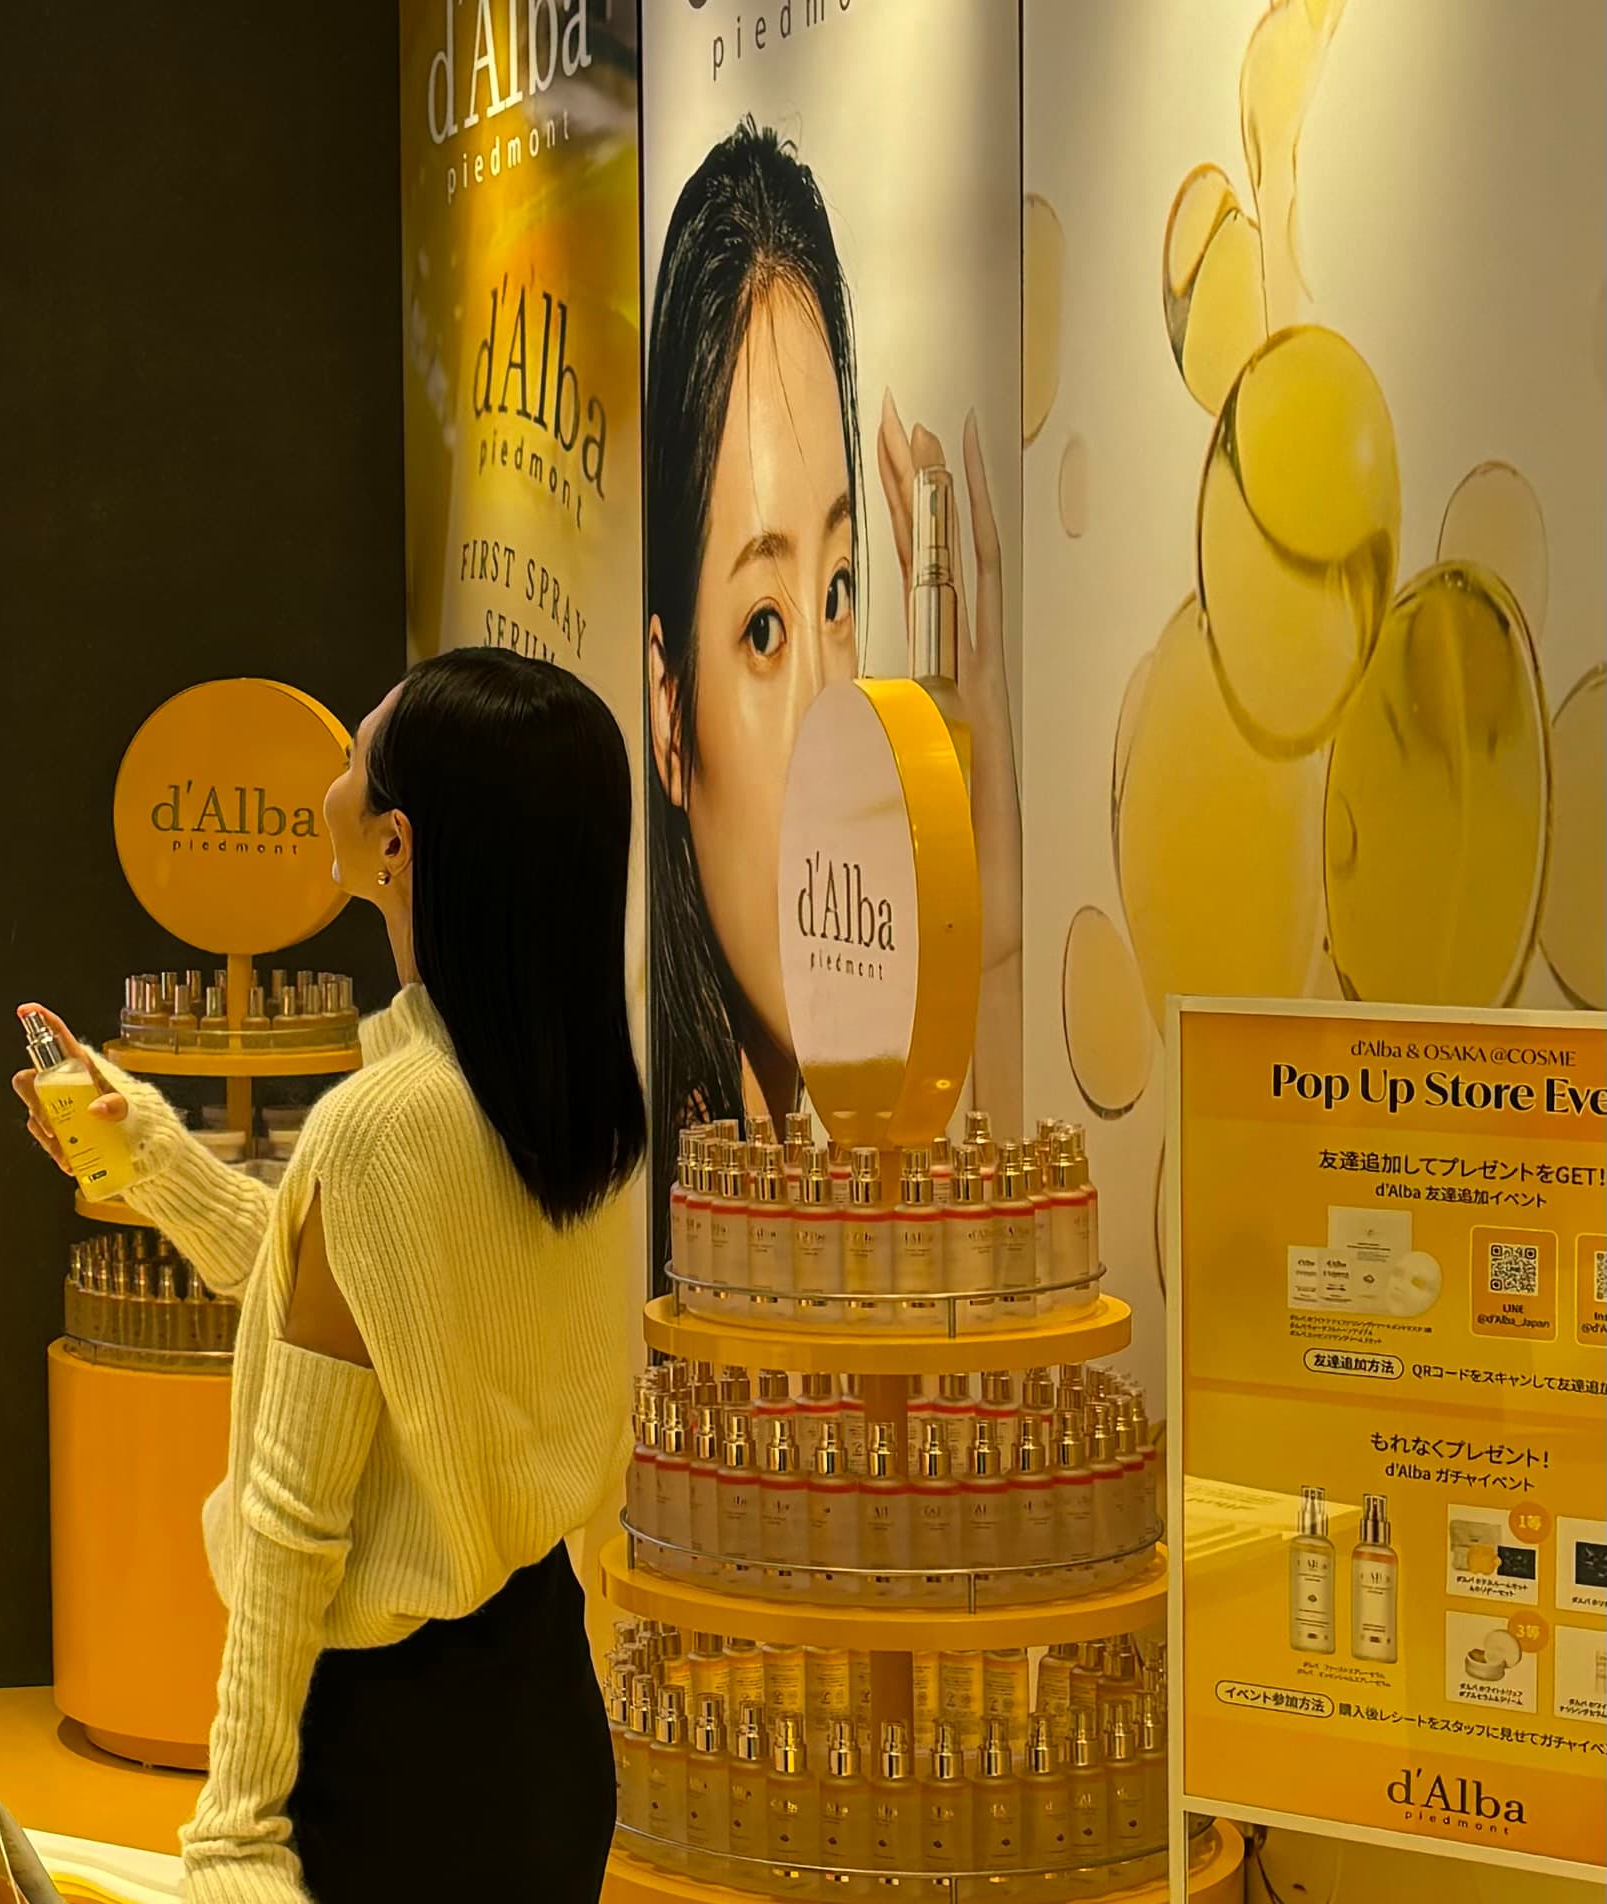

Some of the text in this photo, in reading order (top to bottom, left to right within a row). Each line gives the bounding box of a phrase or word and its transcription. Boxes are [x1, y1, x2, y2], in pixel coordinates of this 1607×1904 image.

[446, 108, 572, 196] piedmont
[472, 271, 607, 502] d'Alba
[478, 434, 582, 532] piedmont
[460, 539, 587, 660] FIRST SPRAY
[151, 780, 319, 838] d'Alba
[797, 850, 895, 951] d'Alba
[1351, 1040, 1577, 1068] d'Alba & OSAKA @COSME
[1272, 1063, 1349, 1110] Pop
[1360, 1067, 1414, 1113] Up
[1425, 1072, 1534, 1111] Store
[1375, 1182, 1547, 1209] d'Alba 友達追加イベント
[1385, 1462, 1535, 1492] d'Alba ガチャイベント
[1225, 1685, 1325, 1714] イベント参加方法
[1338, 1702, 1607, 1756] 購入後レシートをスタッフに見せてガチャイベ
[1387, 1768, 1528, 1825] d'Alba
[1405, 1810, 1509, 1836] piedmont
